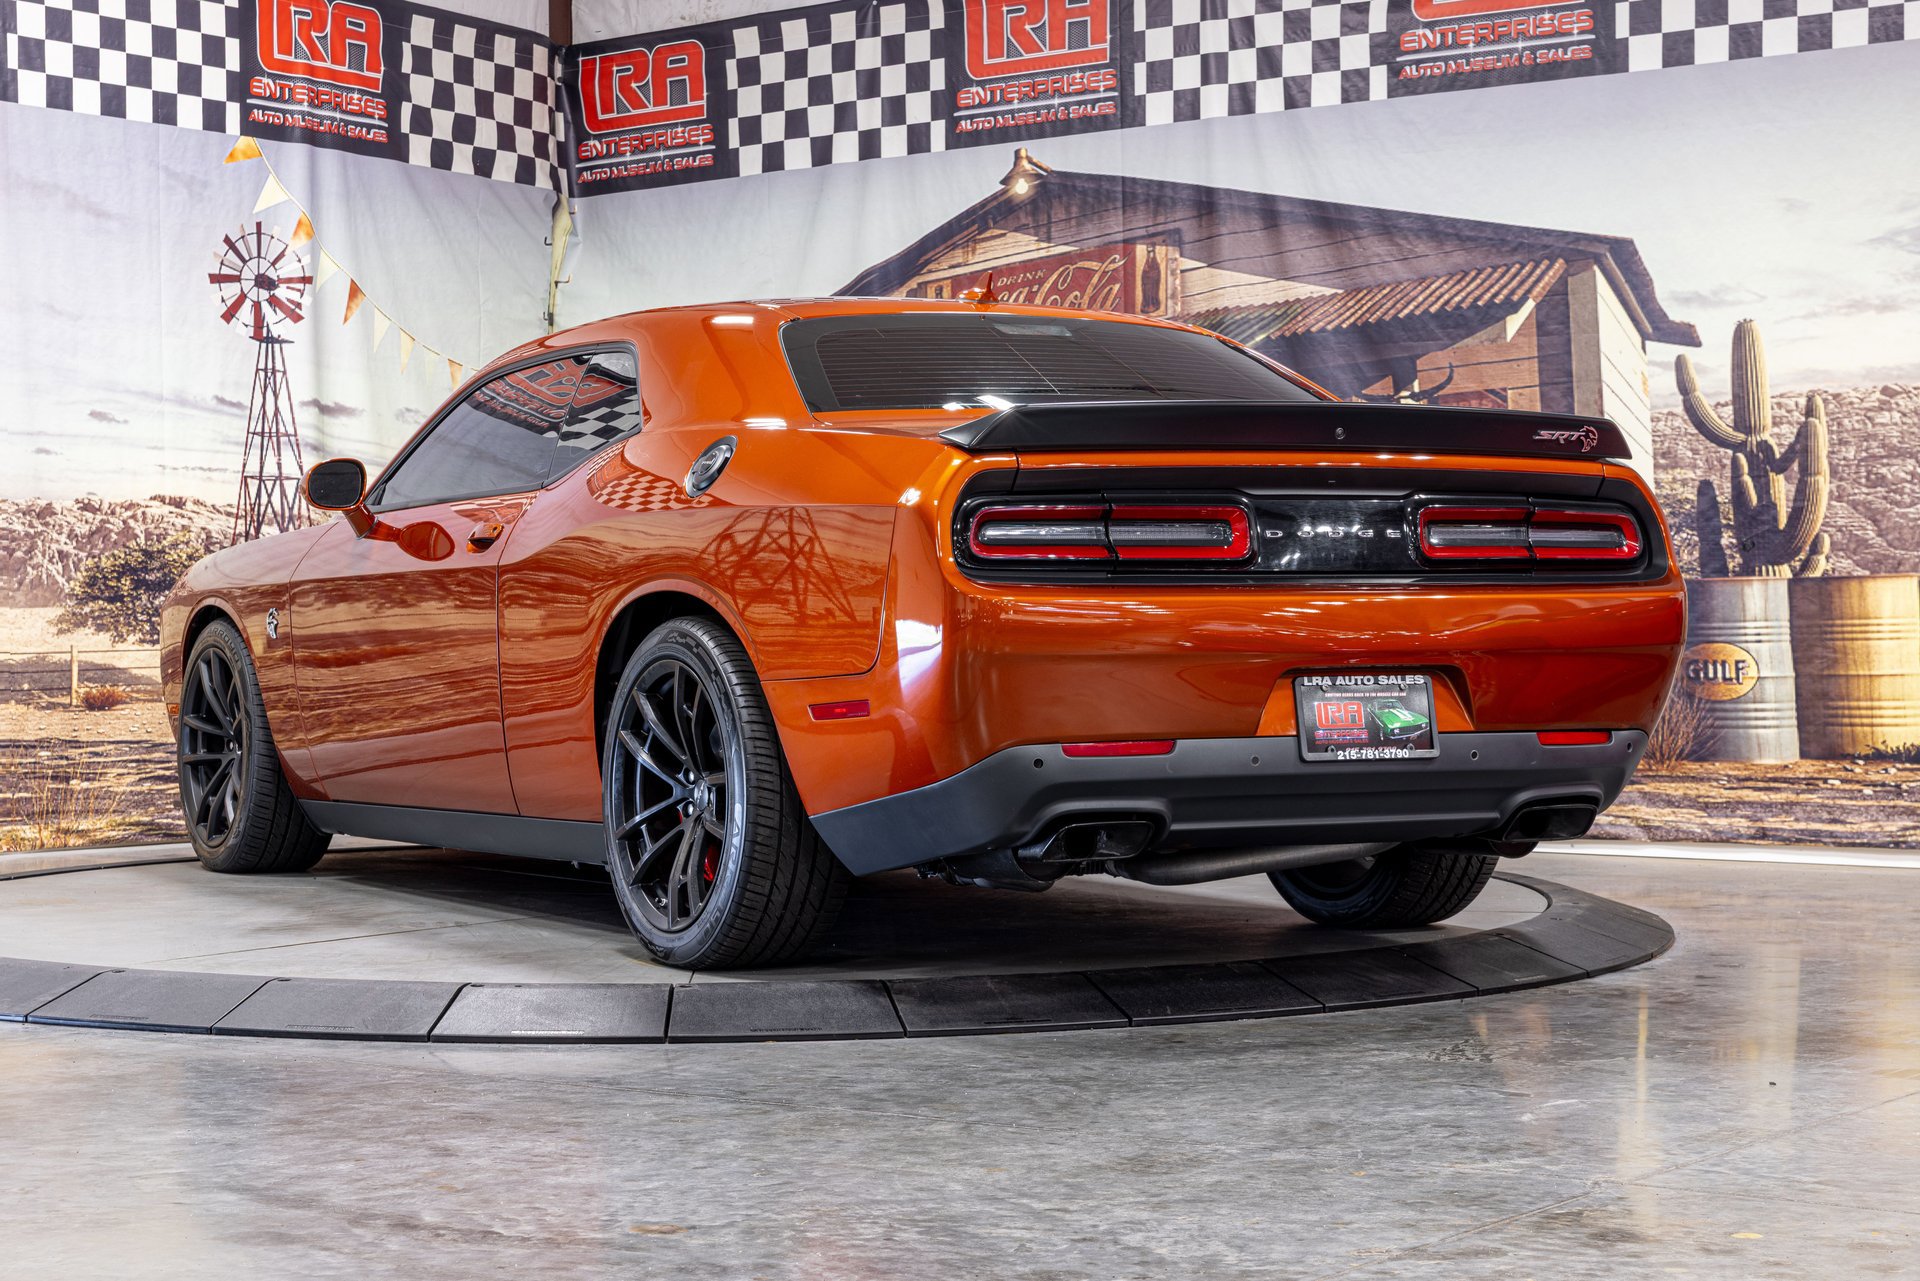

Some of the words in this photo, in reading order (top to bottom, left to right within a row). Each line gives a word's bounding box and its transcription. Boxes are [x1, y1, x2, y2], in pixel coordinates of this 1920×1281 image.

[1400, 9, 1594, 52] ENTERPRISES
[1398, 61, 1445, 79] AUTO
[1447, 54, 1520, 74] MUSEUM
[1522, 50, 1534, 65] &
[1537, 45, 1593, 64] SALES
[250, 76, 388, 119] ENTERPRISES
[579, 39, 707, 134] LRA
[956, 69, 1117, 108] ENTERPRISES
[248, 109, 283, 126] AUTO
[285, 114, 338, 134] MUSEUM
[339, 124, 347, 136] &
[347, 125, 389, 143] SALES
[956, 117, 994, 133] AUTO
[996, 109, 1056, 128] MUSEUM
[1058, 107, 1068, 121] &
[1070, 101, 1117, 118] SALES
[578, 123, 715, 160] ENTERPRISES
[577, 168, 610, 183] AUTO
[611, 160, 663, 178] MUSEUM
[664, 159, 673, 172] &
[674, 154, 715, 170] SALES
[997, 269, 1047, 287] DRINK
[1533, 429, 1585, 444] SRT
[1265, 529, 1401, 538] DODGE
[1303, 675, 1332, 686] LRA
[1335, 675, 1374, 686] AUTO
[1378, 674, 1425, 685] SALES
[1686, 659, 1750, 685] GULF
[1315, 701, 1365, 729] LRA
[1337, 748, 1410, 760] 215-781-3790
